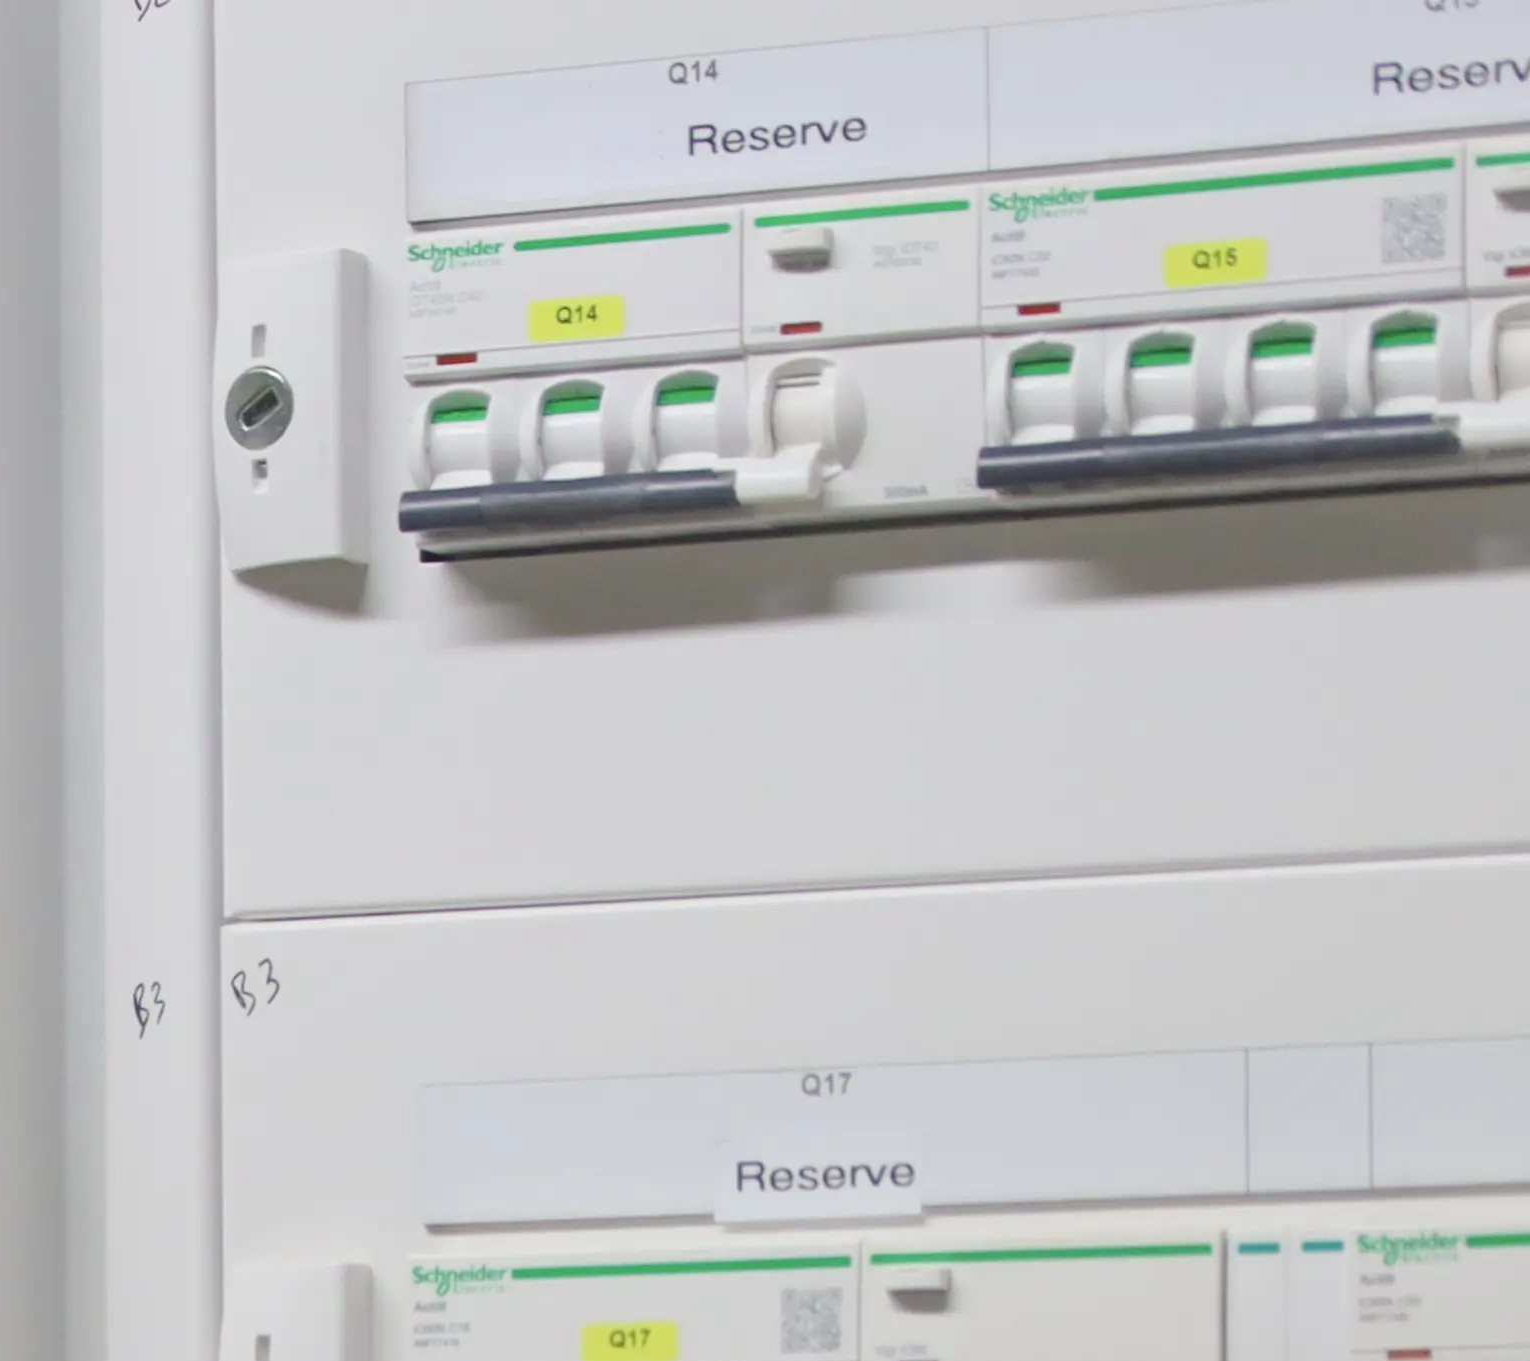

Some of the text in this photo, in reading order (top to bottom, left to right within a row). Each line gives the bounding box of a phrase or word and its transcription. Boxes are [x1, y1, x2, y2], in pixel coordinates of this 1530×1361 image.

[668, 59, 719, 85] Q14
[688, 117, 867, 156] Reserve
[989, 188, 1090, 224] Schneider
[408, 241, 504, 272] Schneider
[1192, 246, 1240, 269] Q15
[556, 305, 598, 325] Q14
[230, 957, 281, 1017] B3
[132, 981, 166, 1039] B3
[801, 1072, 852, 1097] Q17
[736, 1160, 915, 1192] Reserve
[412, 1266, 507, 1296] Schneider
[609, 1328, 651, 1349] Q17
